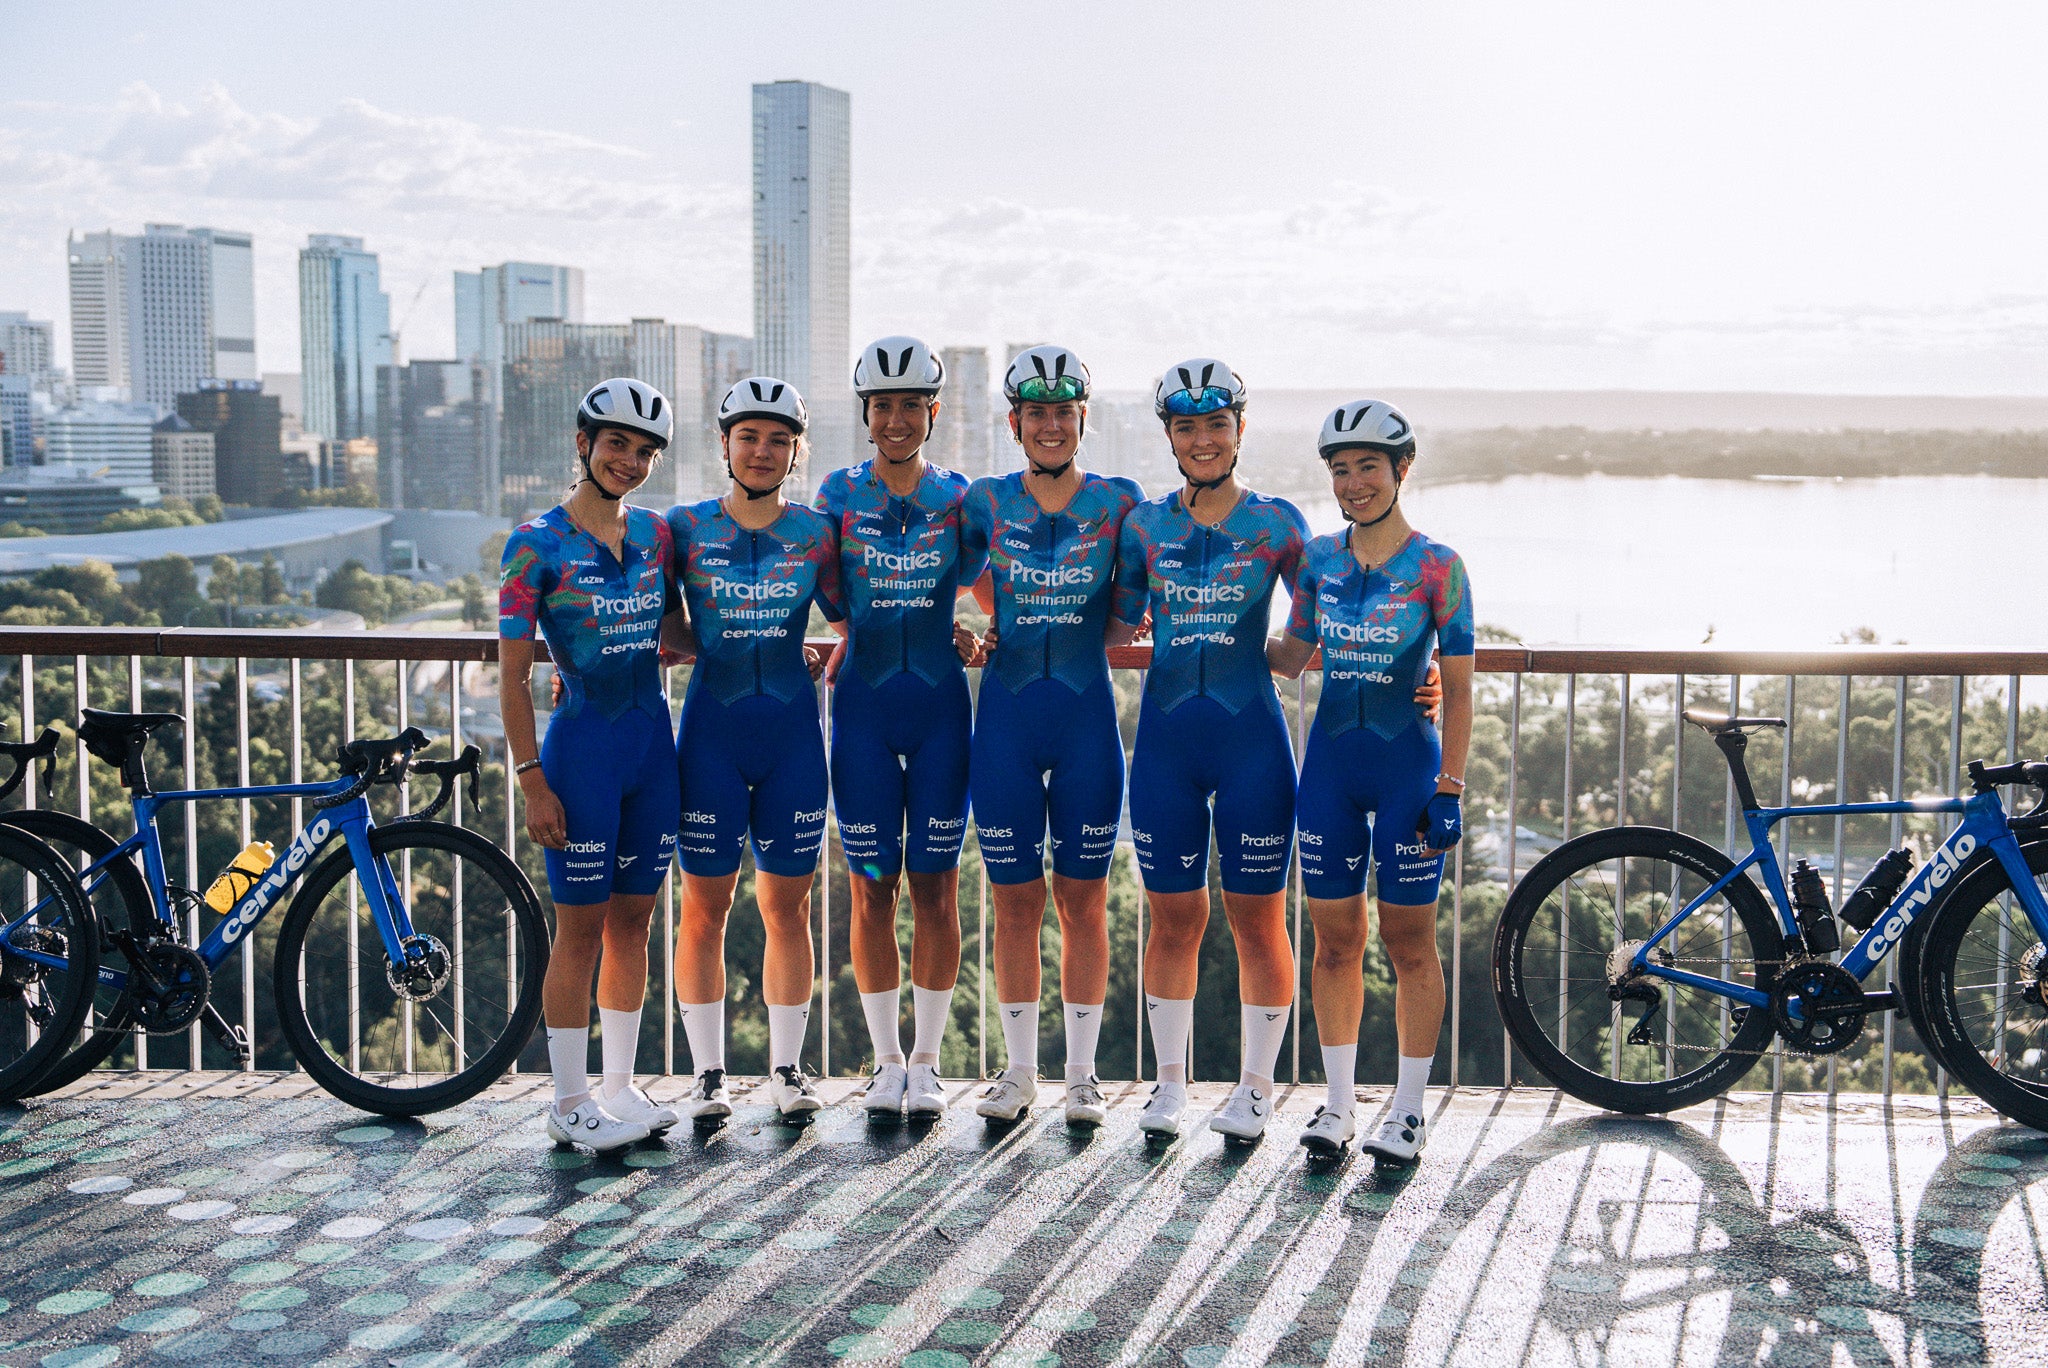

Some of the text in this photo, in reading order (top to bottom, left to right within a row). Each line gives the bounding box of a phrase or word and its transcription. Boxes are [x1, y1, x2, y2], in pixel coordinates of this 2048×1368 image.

[857, 527, 882, 537] LAZER
[1005, 538, 1031, 551] LAZER
[702, 558, 730, 566] LAZER
[864, 545, 941, 571] Praties
[1159, 559, 1182, 569] LAZER
[1010, 559, 1093, 586] Praties
[578, 576, 605, 584] LAZER
[870, 578, 936, 590] SHIMANO
[711, 576, 798, 600] Praties
[1164, 580, 1245, 603] Praties
[592, 591, 662, 616] Praties
[872, 597, 934, 608] cervélo
[1015, 594, 1088, 605] SHIMANO
[1320, 593, 1339, 605] LAZER
[719, 608, 790, 620] SHIMANO
[1016, 613, 1083, 625] cervélo
[1171, 613, 1237, 625] SHIMANO
[600, 619, 658, 636] SHIMANO
[722, 626, 788, 639] cervélo
[1321, 613, 1399, 643] Praties
[1171, 632, 1235, 646] cervélo
[601, 638, 657, 655] cervélo
[1327, 648, 1394, 664] SHIMANO
[1330, 670, 1394, 684] cervélo
[681, 810, 716, 824] raties
[928, 816, 965, 830] Praties
[928, 833, 962, 842] SHIMANO
[1241, 833, 1285, 847] Praties
[1395, 840, 1427, 856] Prati
[1242, 852, 1283, 861] SHIMANO
[1240, 865, 1282, 873] cervélo
[1399, 859, 1438, 870] SHIMANO
[222, 819, 331, 944] cervélo
[566, 874, 604, 882] cervélo
[1398, 873, 1437, 883] cervélo
[1866, 834, 1976, 961] cervélo
